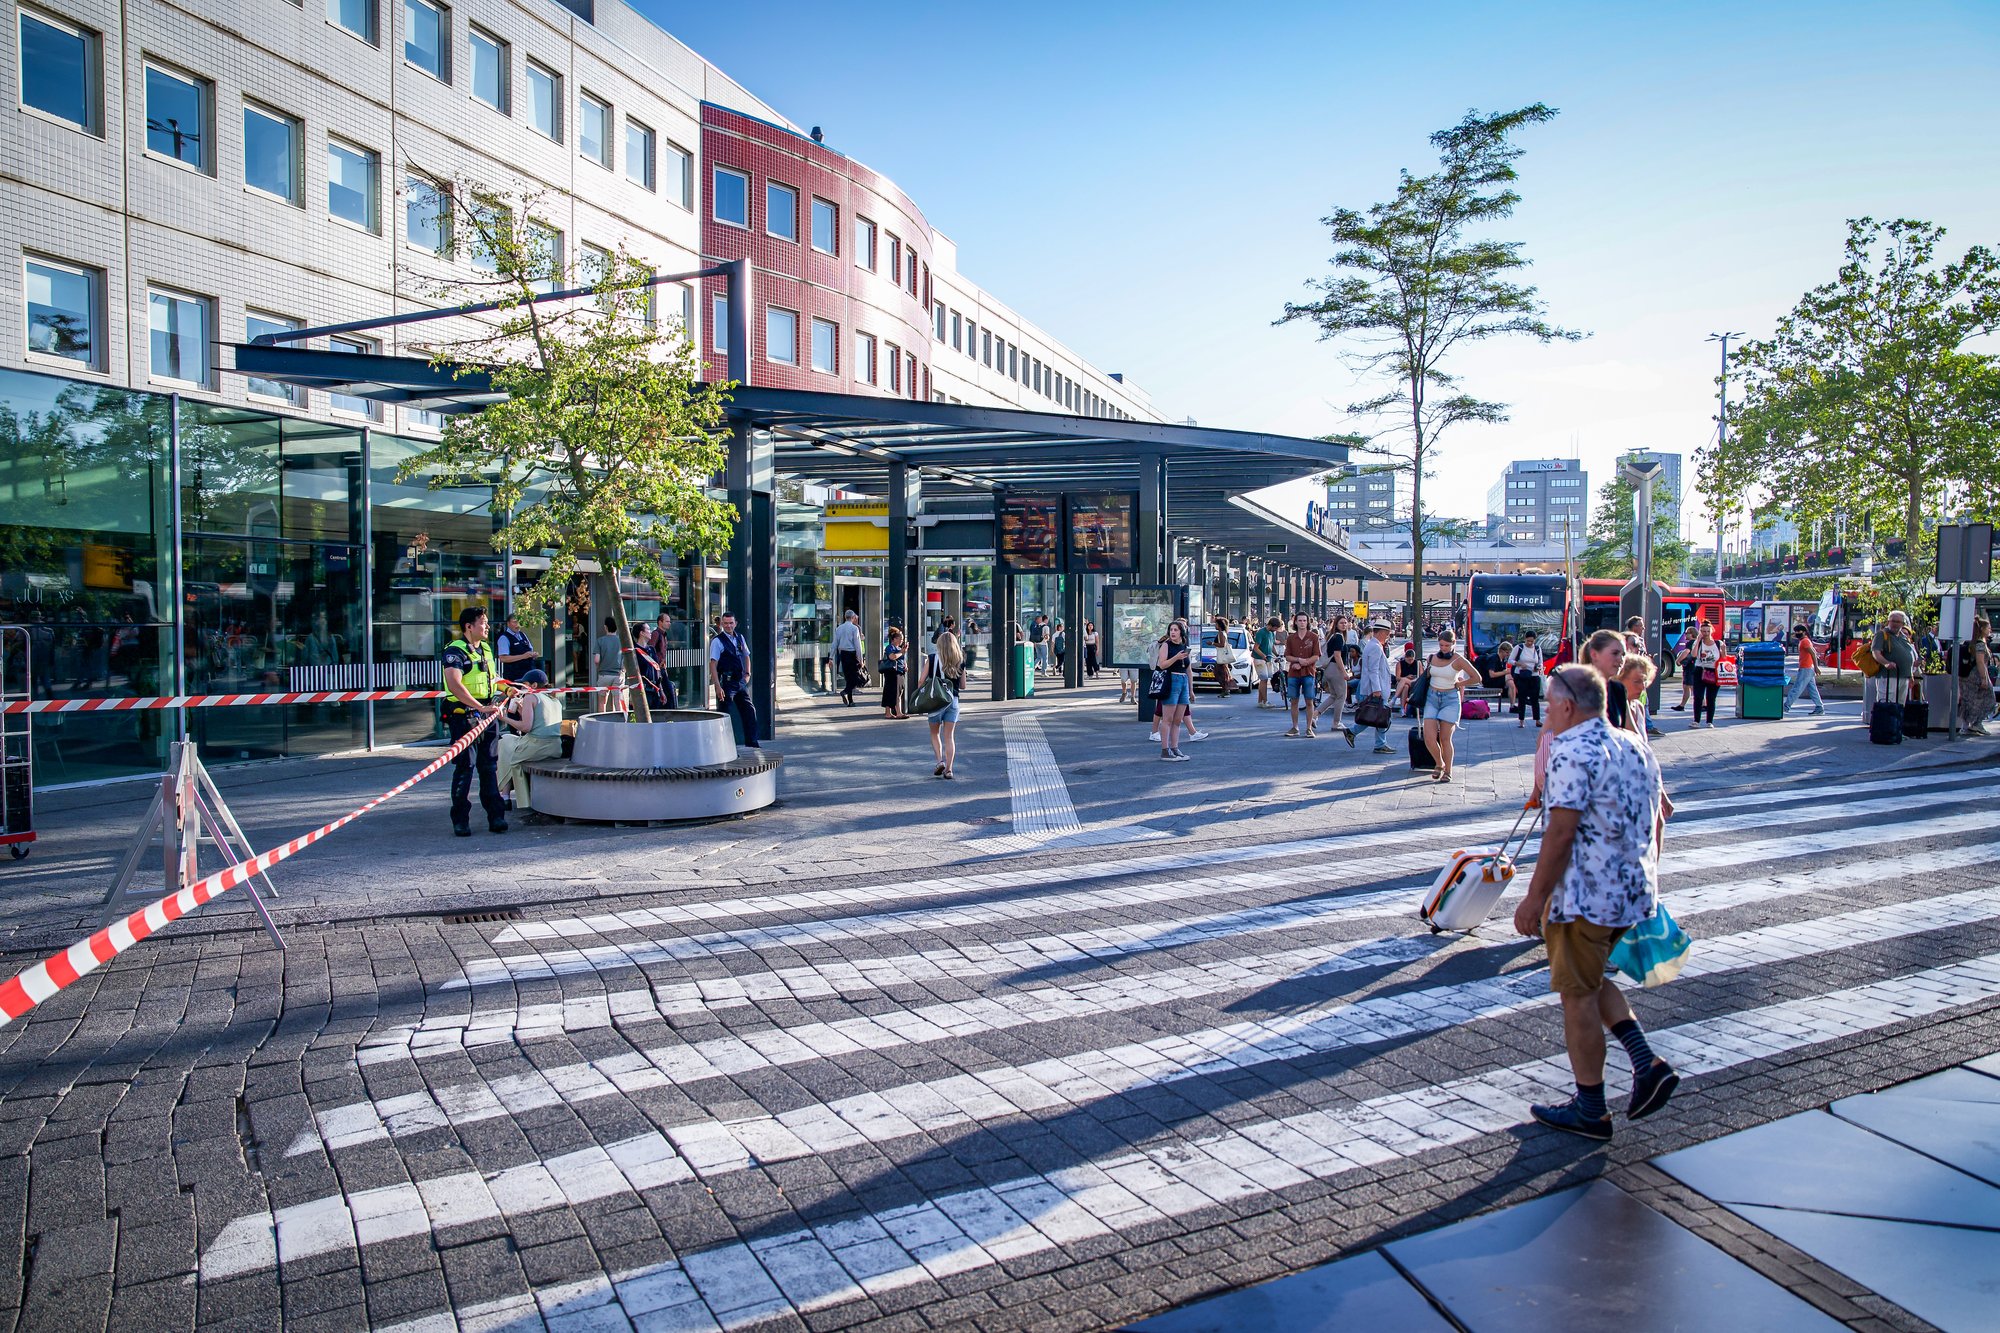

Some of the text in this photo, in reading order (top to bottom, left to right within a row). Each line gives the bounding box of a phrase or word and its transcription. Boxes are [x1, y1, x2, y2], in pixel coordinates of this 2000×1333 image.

[497, 564, 504, 577] B
[1487, 594, 1545, 604] 401 Airport
